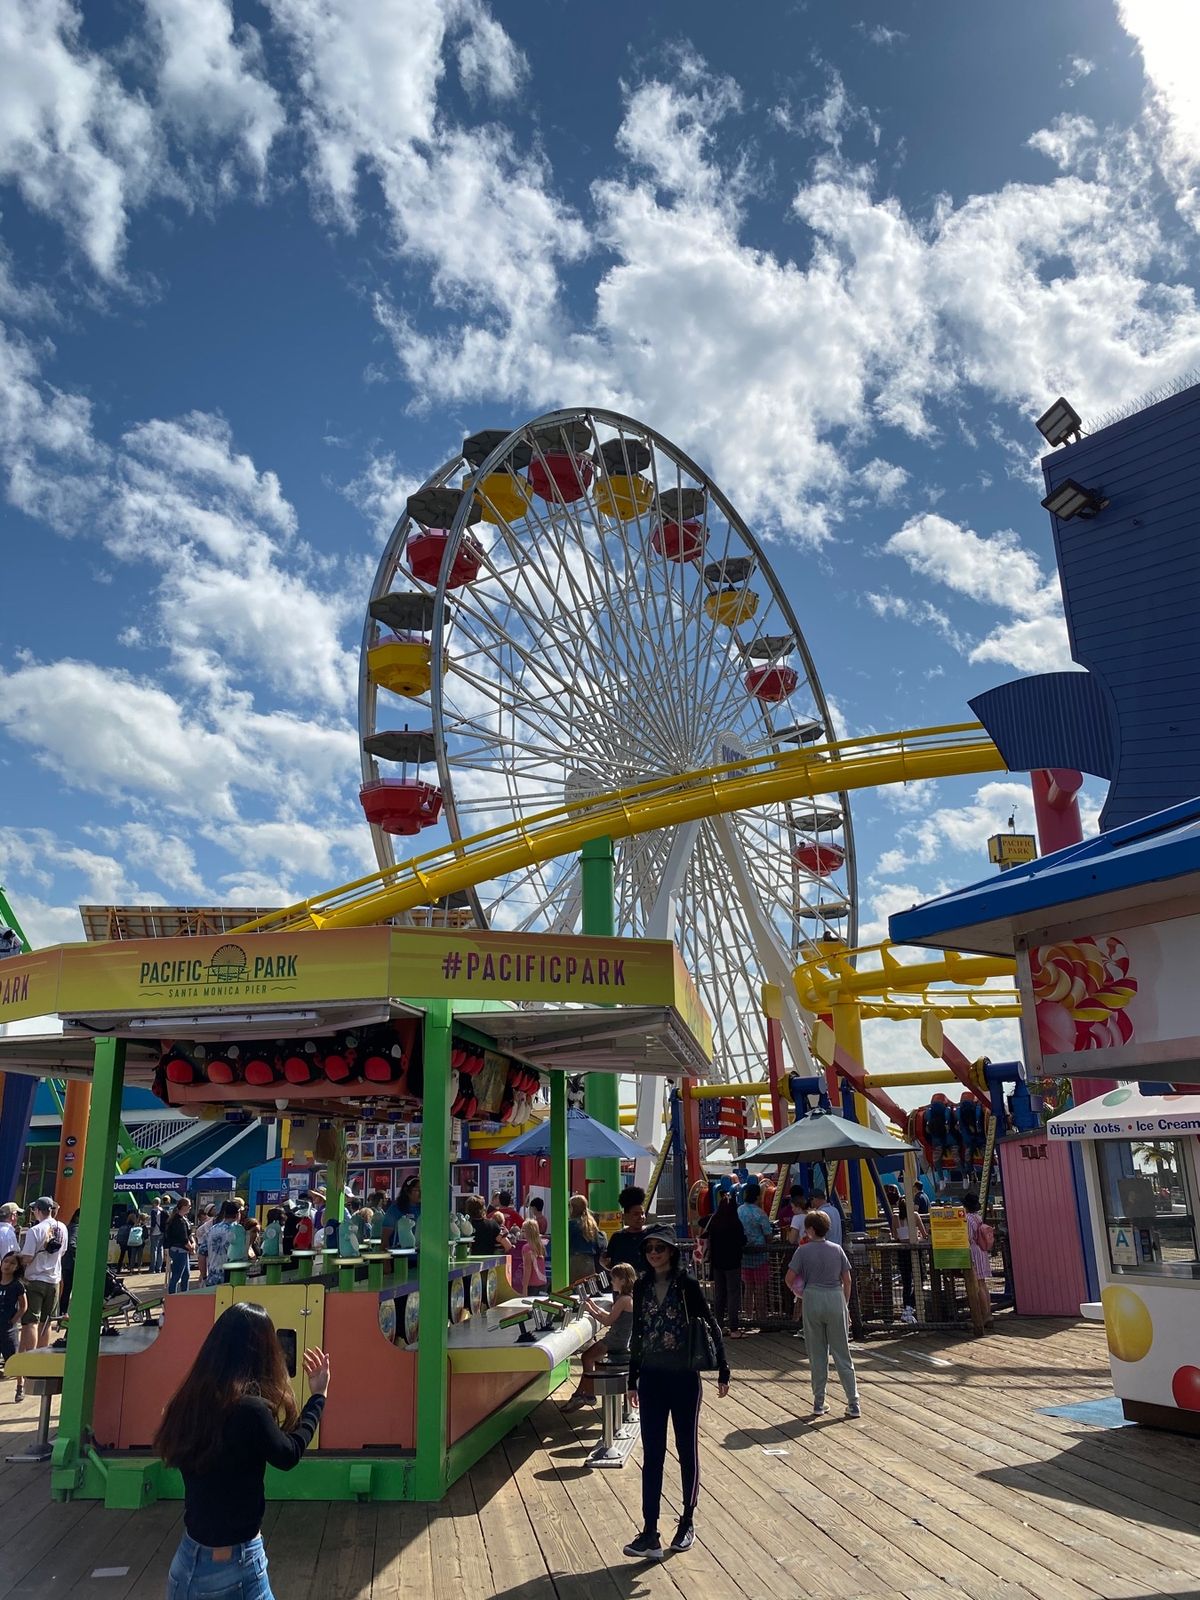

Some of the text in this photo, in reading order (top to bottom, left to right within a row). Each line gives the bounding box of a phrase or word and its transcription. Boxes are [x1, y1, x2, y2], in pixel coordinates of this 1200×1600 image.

[140, 955, 298, 984] PACIFIC PARK
[441, 951, 625, 986] #PACIFICPARK
[0, 974, 30, 1005] ARK
[168, 984, 267, 998] SANTA MONICA PIER
[1136, 1120, 1154, 1131] Ice
[1158, 1119, 1200, 1130] Cream
[145, 1181, 180, 1190] Pretzels
[1116, 1230, 1129, 1247] A
